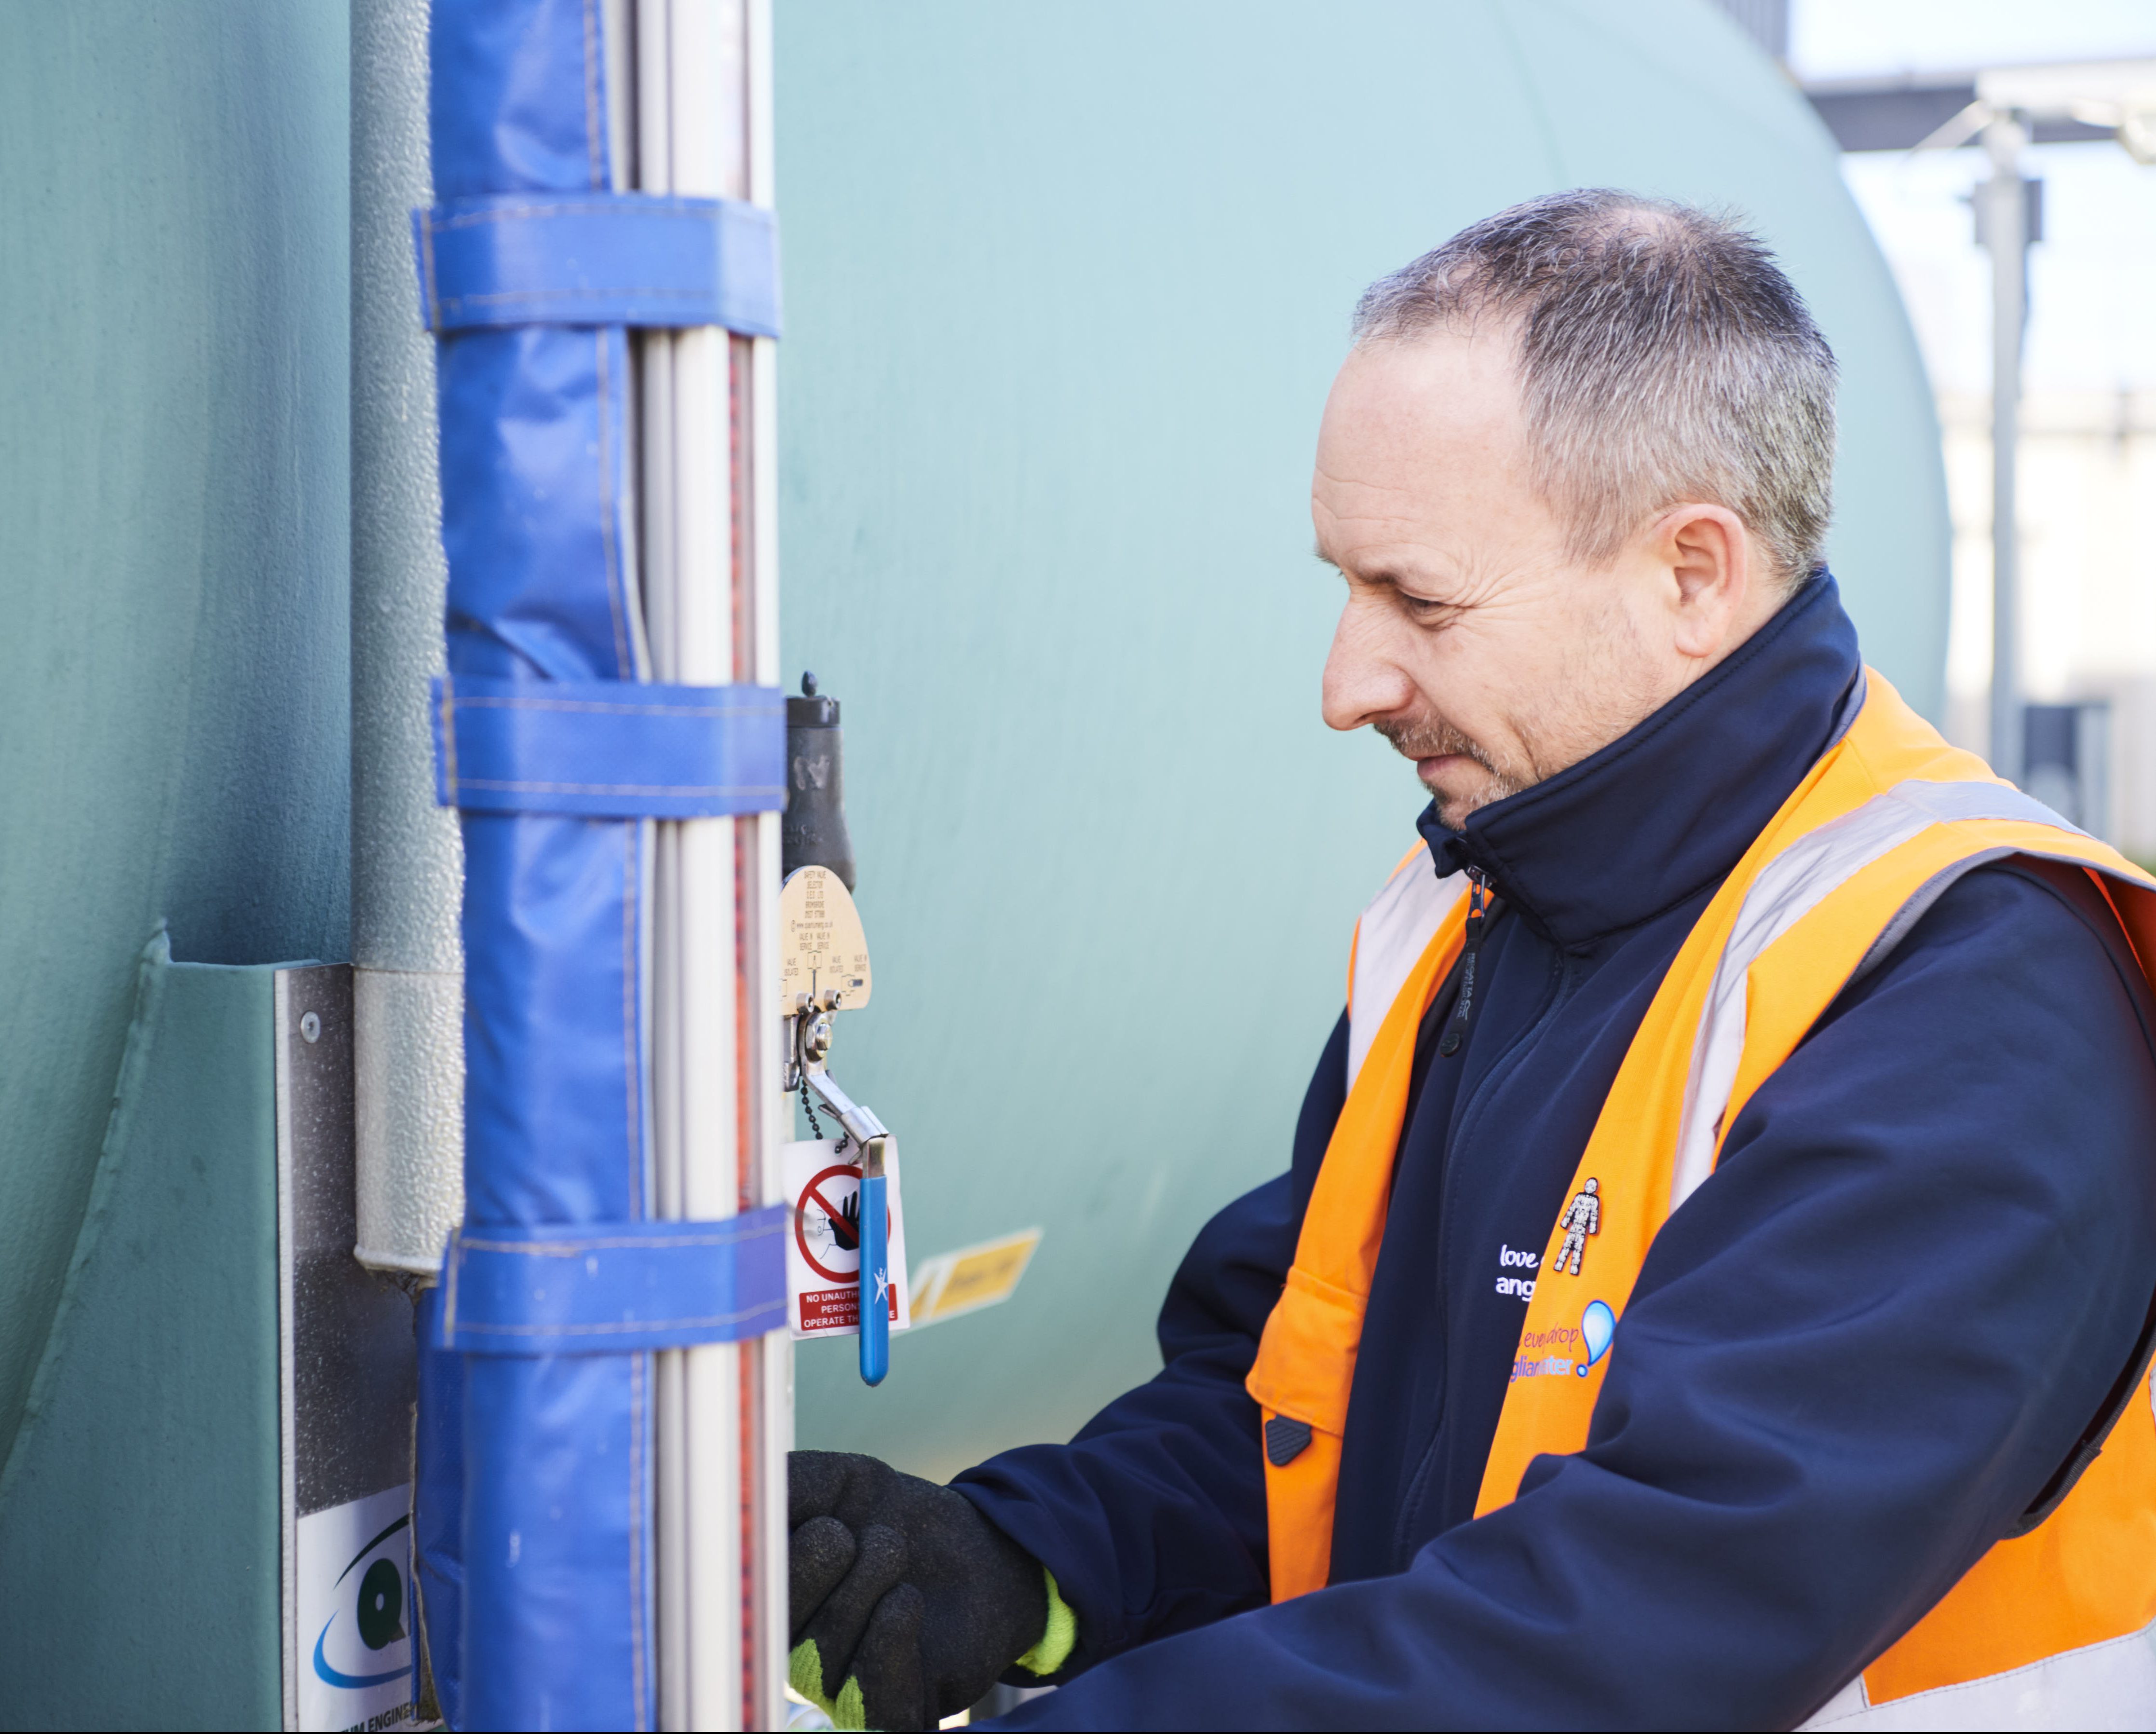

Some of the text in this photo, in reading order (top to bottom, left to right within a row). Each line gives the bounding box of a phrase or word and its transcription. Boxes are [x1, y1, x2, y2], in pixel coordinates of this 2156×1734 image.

[1500, 1244, 1539, 1268] love
[806, 1291, 860, 1303] NO UNAUTH
[1495, 1277, 1537, 1302] ang
[804, 1315, 858, 1328] OPERATE TH
[1546, 1322, 1579, 1352] drop
[357, 1548, 410, 1651] Q
[368, 1700, 412, 1732] ENGINE
